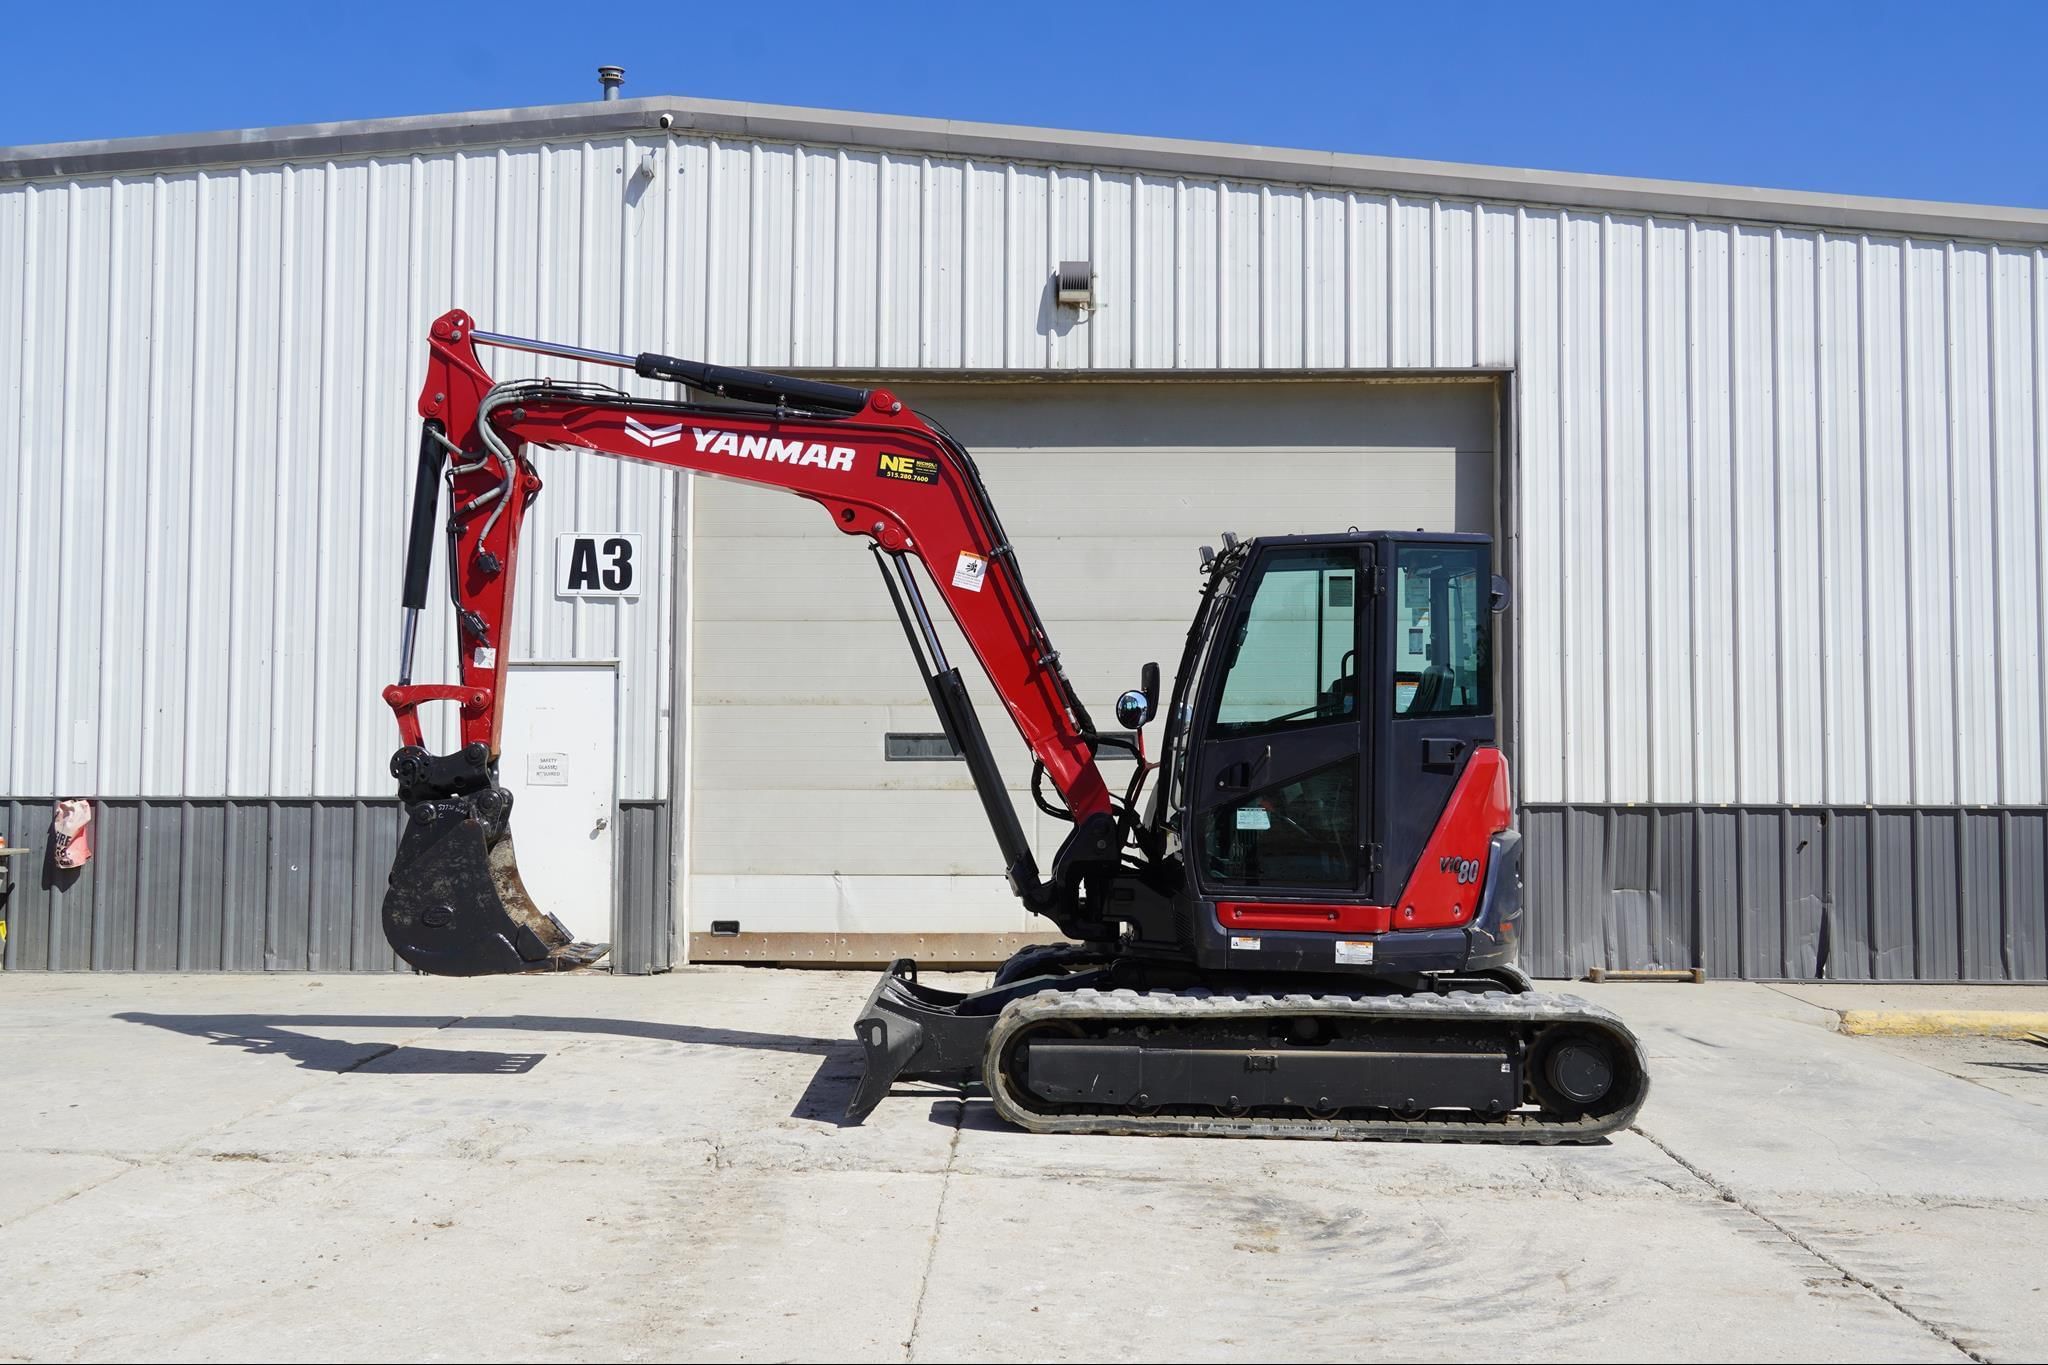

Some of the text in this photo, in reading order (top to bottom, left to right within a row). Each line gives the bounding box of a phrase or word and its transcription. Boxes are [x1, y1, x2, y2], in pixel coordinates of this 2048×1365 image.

[692, 427, 856, 472] YANMAR
[879, 454, 915, 474] NE
[886, 471, 929, 483] 515.280.7600
[567, 538, 633, 591] A3
